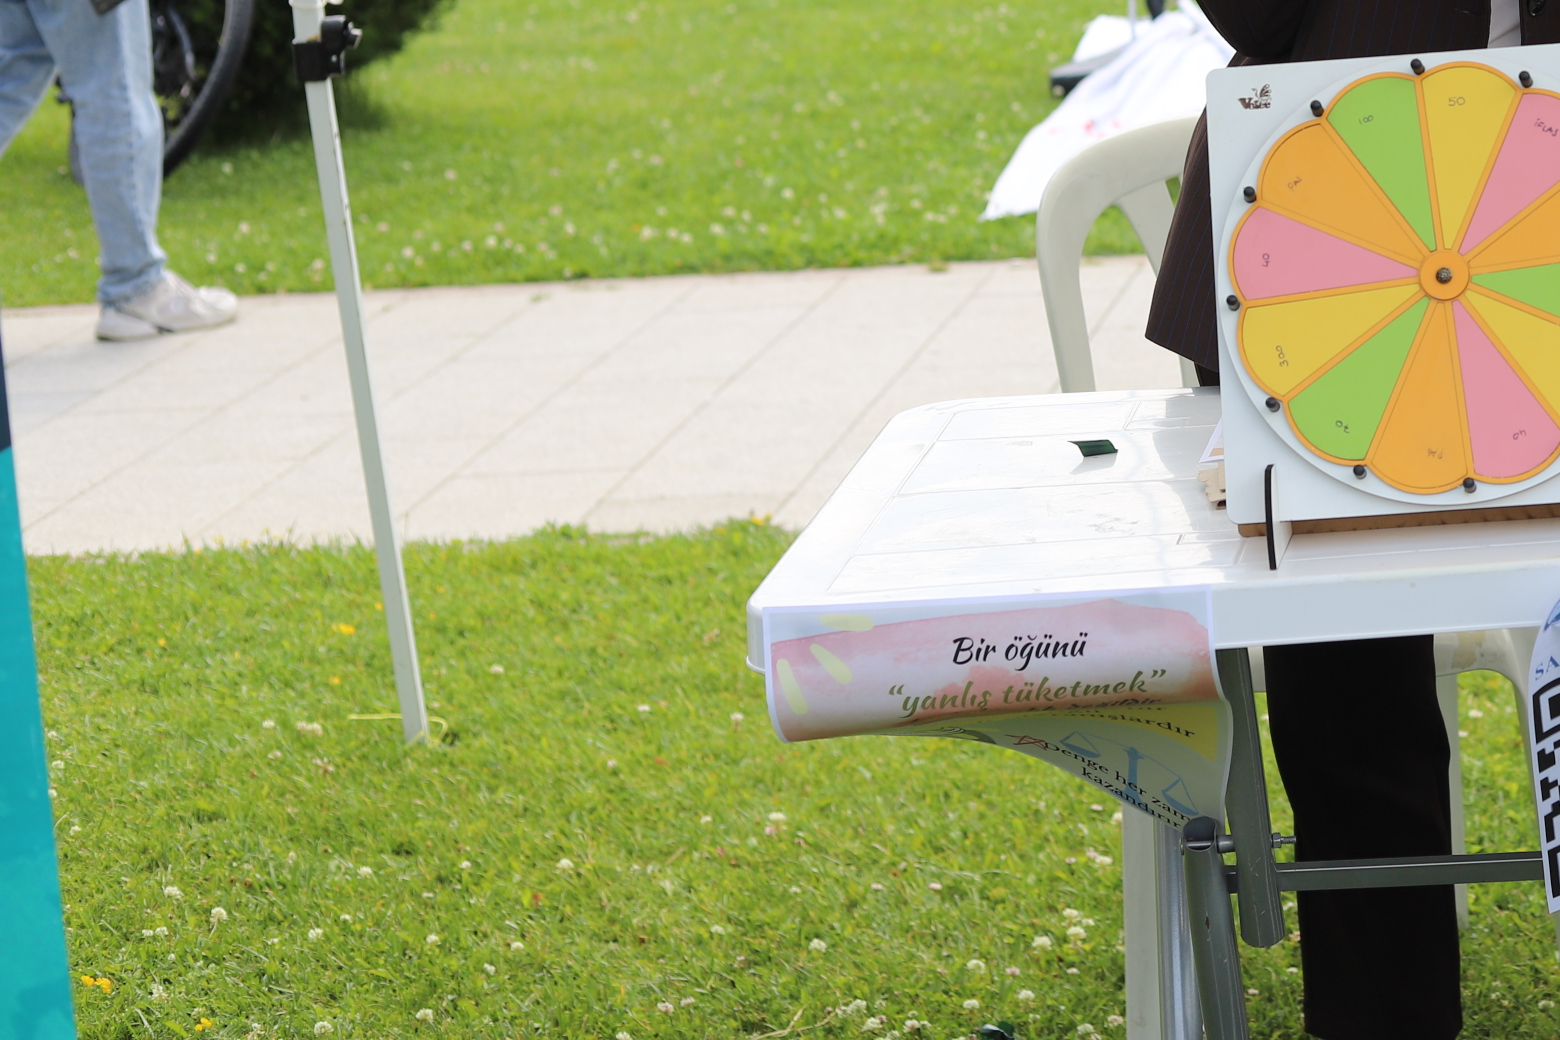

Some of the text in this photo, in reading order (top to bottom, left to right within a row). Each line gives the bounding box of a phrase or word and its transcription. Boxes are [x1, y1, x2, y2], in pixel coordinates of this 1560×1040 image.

[1447, 96, 1466, 107] 50
[1262, 253, 1271, 268] 40
[1275, 344, 1289, 368] 300
[1334, 419, 1351, 434] 70
[952, 632, 1089, 672] Bir öğünü
[1044, 741, 1192, 823] Denge her zam
[1081, 766, 1183, 829] kazandırır
